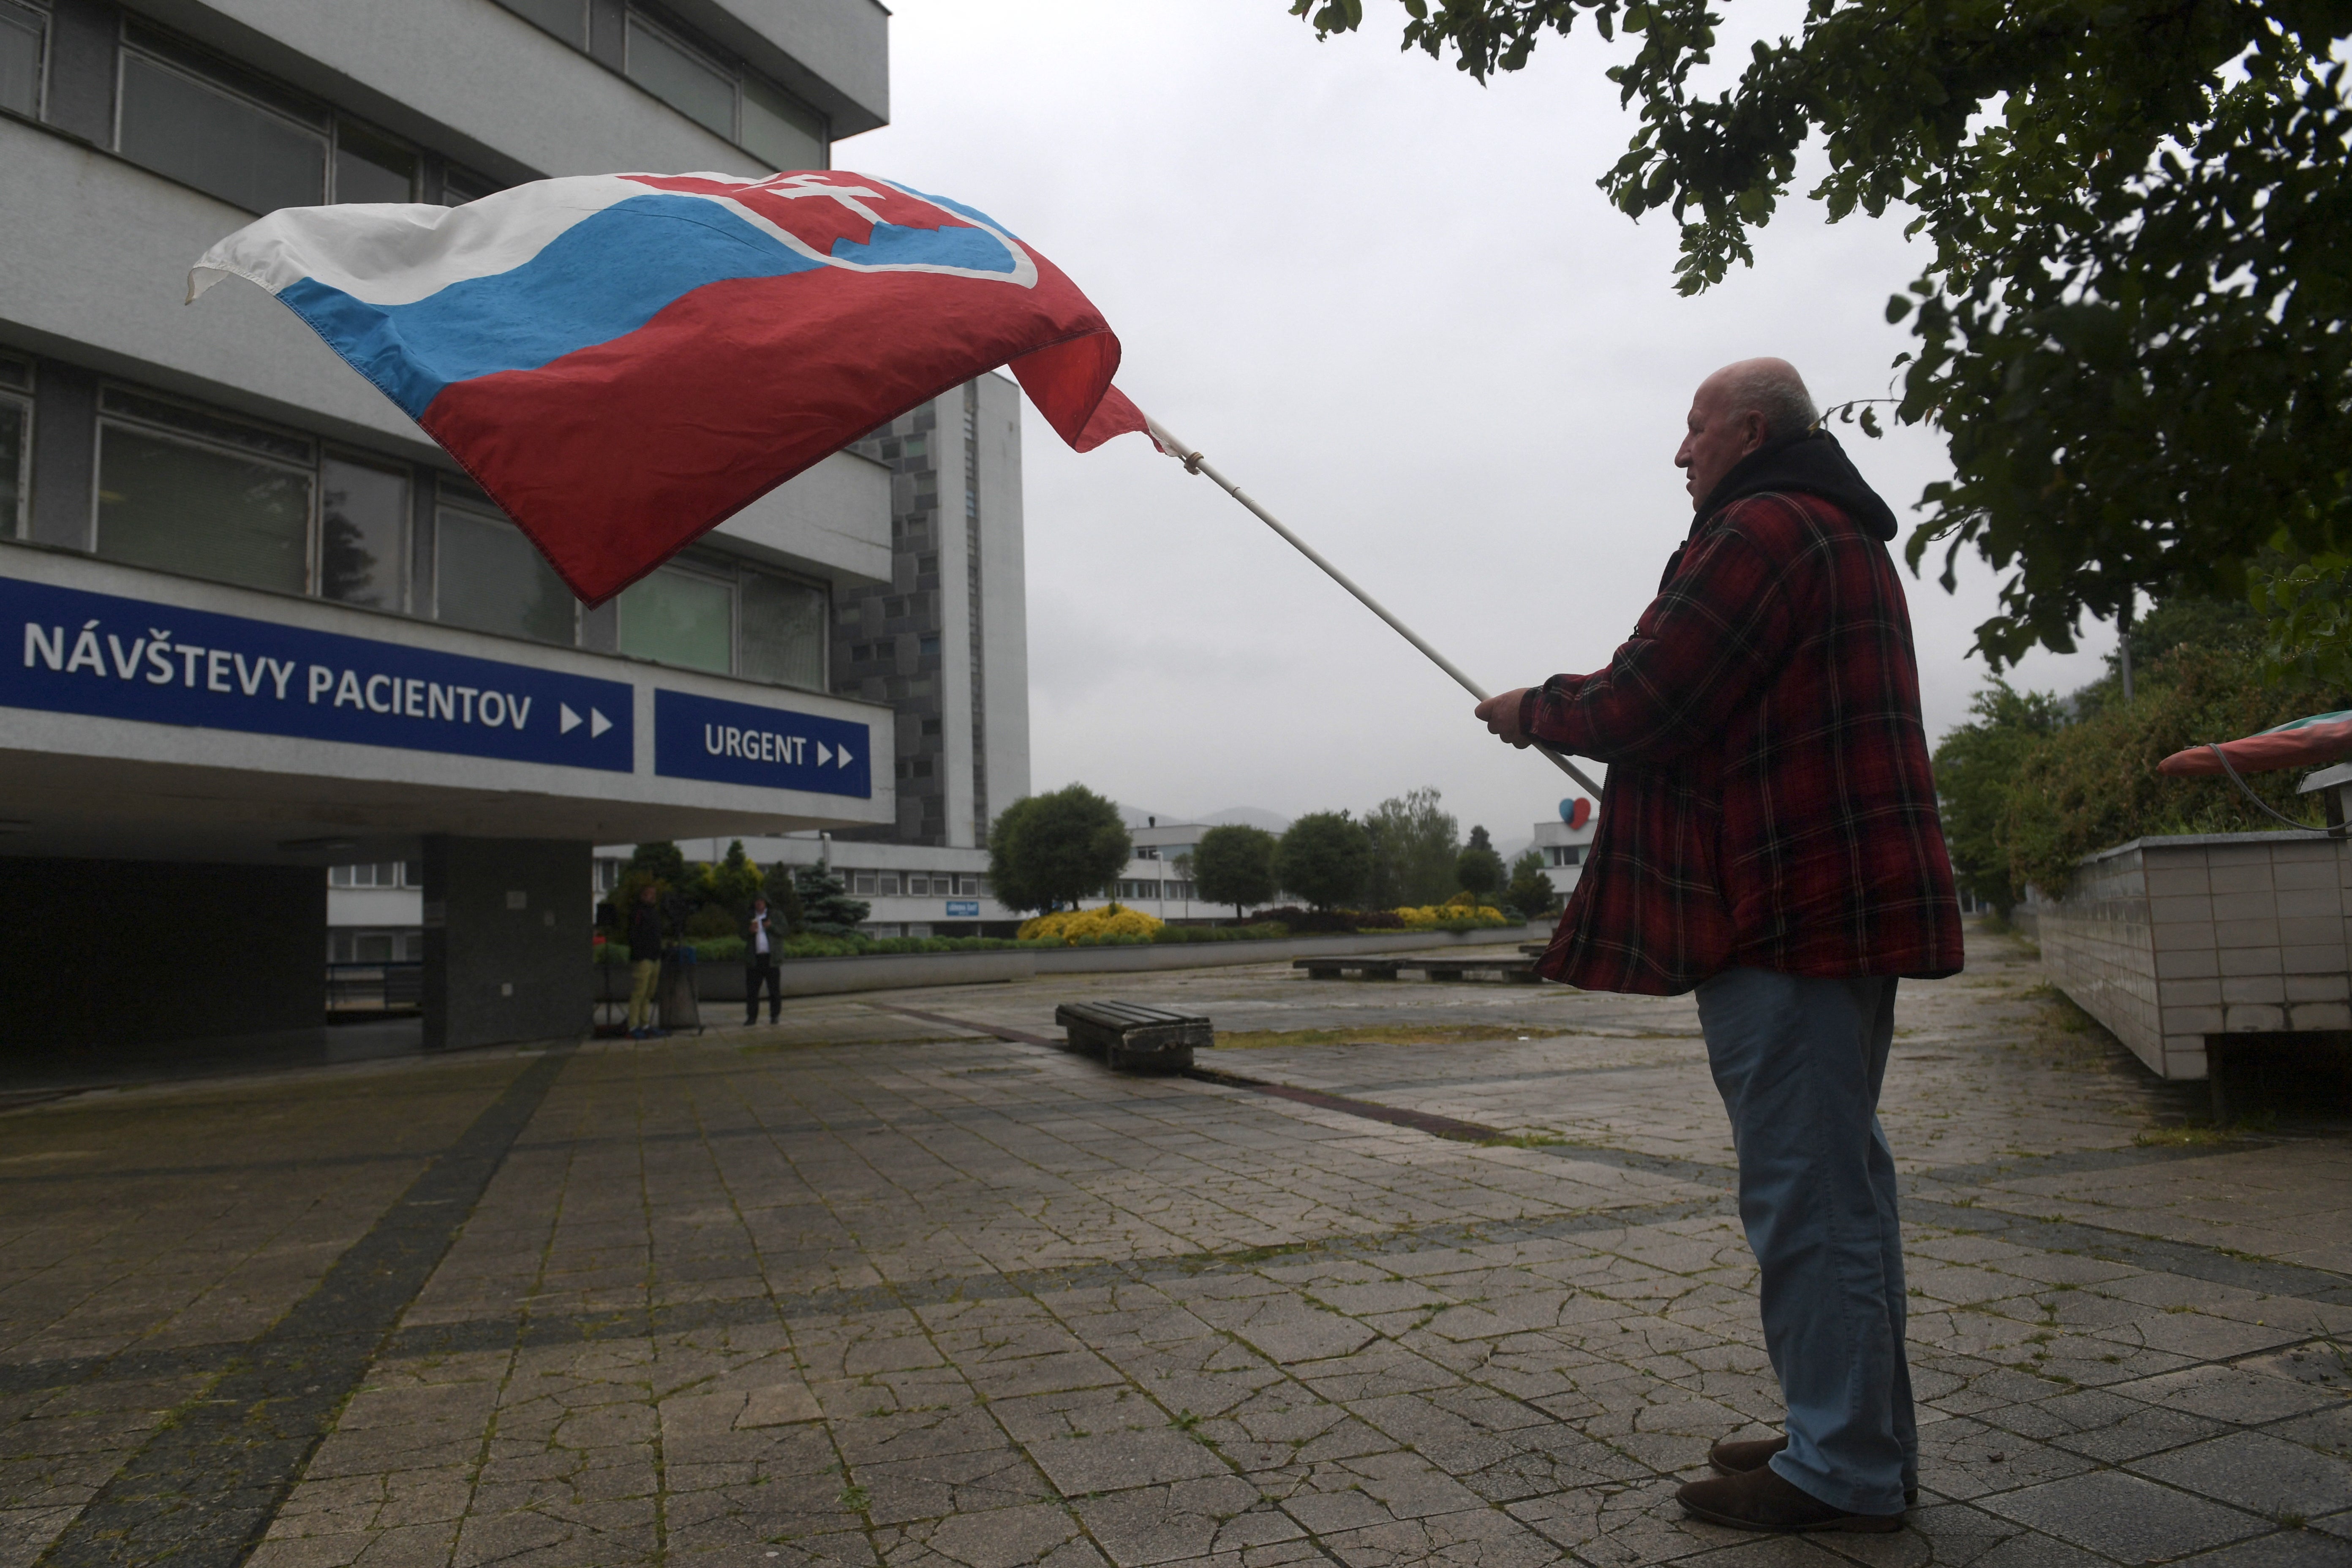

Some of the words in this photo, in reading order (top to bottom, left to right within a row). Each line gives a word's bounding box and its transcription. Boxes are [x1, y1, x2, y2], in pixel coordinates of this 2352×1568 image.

[24, 620, 294, 699] NÁVŠTEVY
[308, 665, 531, 730] PACIENTOV
[705, 724, 806, 765] URGENT
